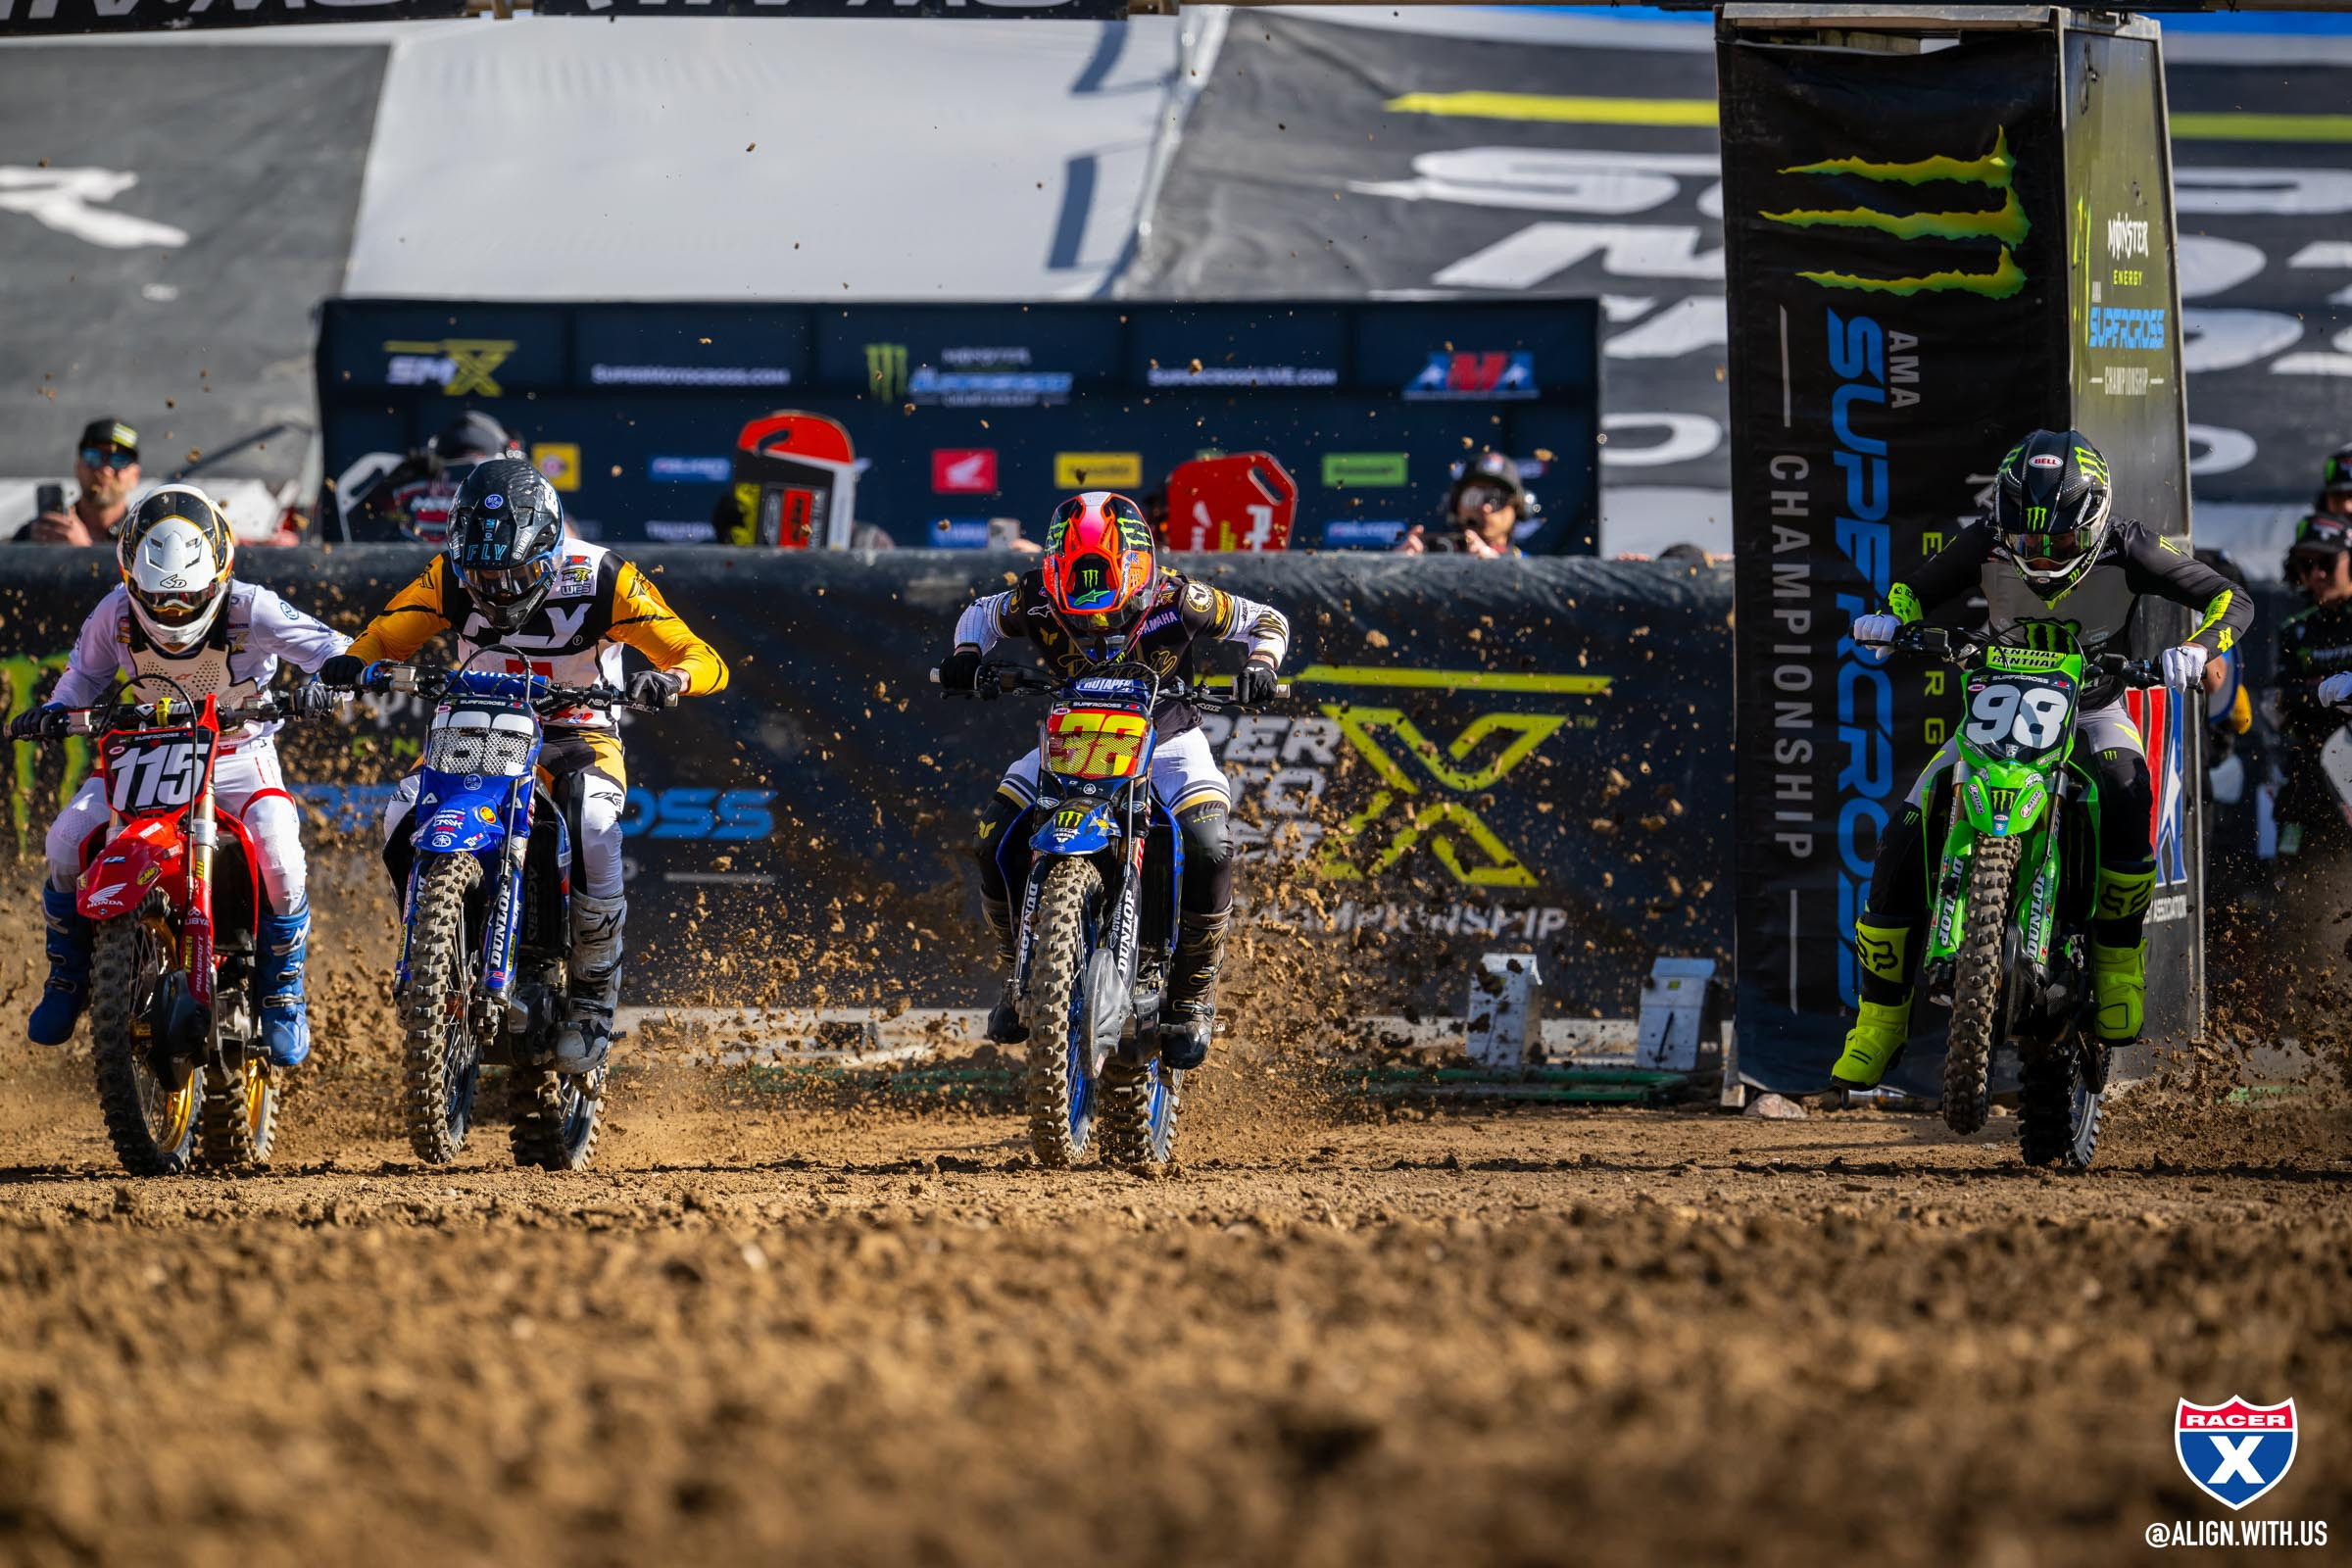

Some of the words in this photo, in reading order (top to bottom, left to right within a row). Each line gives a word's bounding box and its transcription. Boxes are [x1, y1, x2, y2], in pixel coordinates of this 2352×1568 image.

[2108, 212, 2148, 261] MONSTER
[2113, 270, 2142, 285] ENERGY
[1888, 329, 1921, 409] AMA
[2105, 367, 2148, 395] CHAMPIONSHIP
[2034, 457, 2058, 466] BELL
[466, 543, 508, 561] FLY
[1769, 455, 1814, 858] CHAMPIONSHIP
[1992, 656, 2057, 667] RENTHAL
[588, 699, 612, 709] ASV
[1966, 684, 2069, 749] 98
[111, 743, 211, 812] 115
[86, 898, 124, 909] HONDA
[490, 885, 512, 967] DUNLOP
[1020, 882, 1039, 964] DUNLOP
[1117, 889, 1135, 974] DUNLOP
